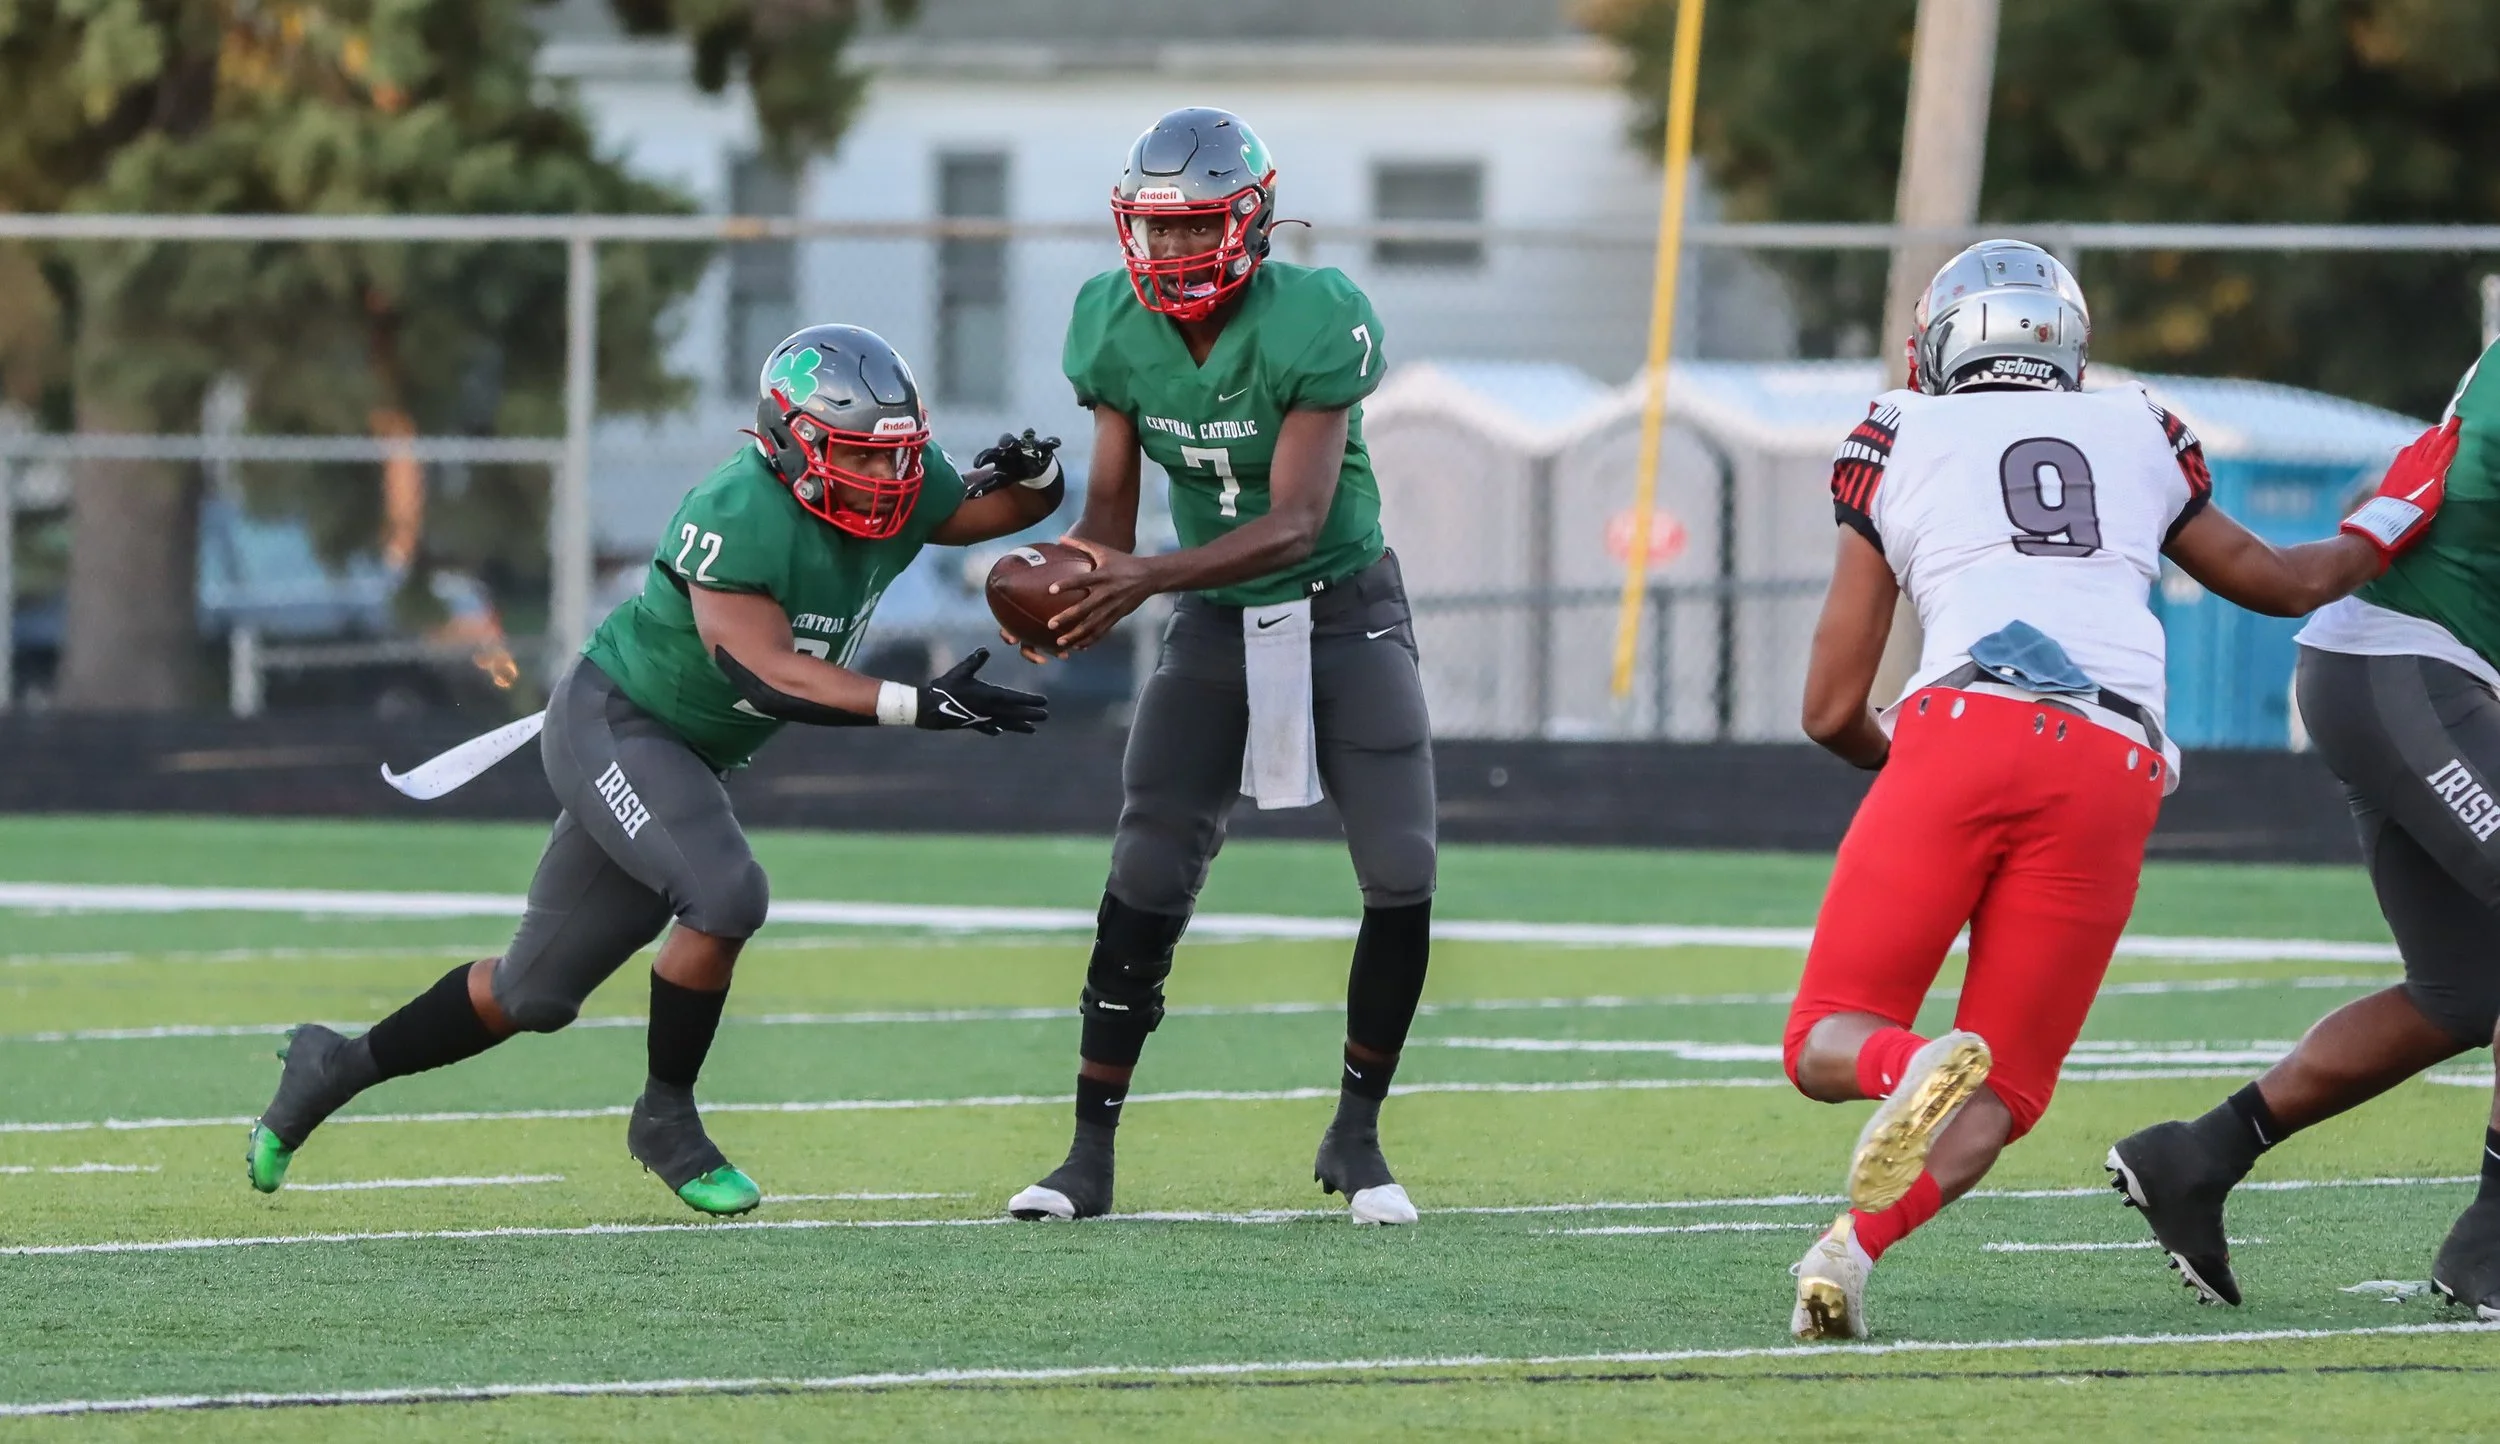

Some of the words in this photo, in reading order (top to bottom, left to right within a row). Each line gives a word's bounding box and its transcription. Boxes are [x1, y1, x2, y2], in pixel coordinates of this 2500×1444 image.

[1140, 191, 1177, 200] Riddell
[1351, 323, 1372, 377] 7
[1992, 357, 2053, 378] schutt
[1145, 416, 1196, 440] CENTRAL
[1199, 420, 1258, 440] CATHOLIC
[1180, 445, 1240, 518] 7
[1999, 437, 2103, 557] 9
[675, 522, 723, 582] 22
[1311, 580, 1325, 592] M
[792, 613, 845, 633] CENTRAL
[595, 760, 651, 840] IRISH
[2425, 758, 2500, 842] IRISH
